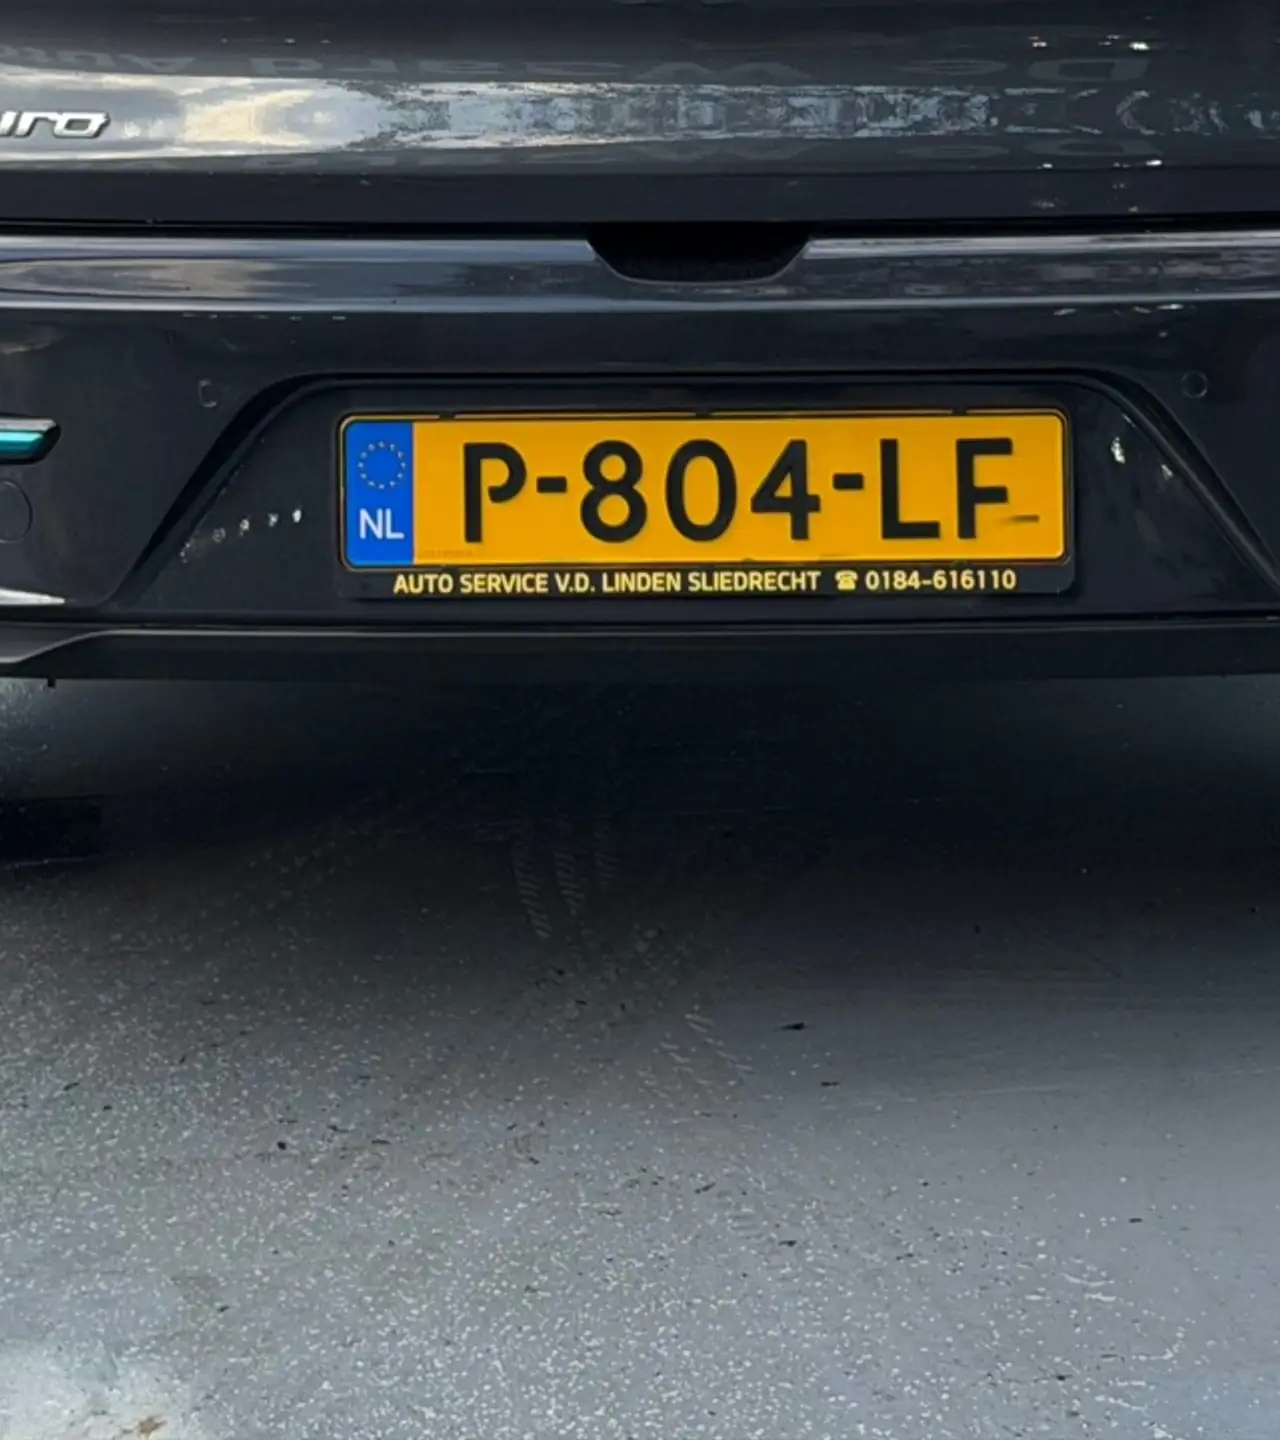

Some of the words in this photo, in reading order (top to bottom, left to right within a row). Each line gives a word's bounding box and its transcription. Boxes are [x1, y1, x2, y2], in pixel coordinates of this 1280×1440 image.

[463, 437, 1014, 544] P-804-LF
[359, 508, 405, 540] NL
[393, 573, 455, 594] AUTO
[459, 572, 549, 594] SERVICE
[553, 572, 596, 593] V.D.
[601, 571, 682, 592] LINDEN
[687, 570, 821, 592] SLIEDRECHT
[865, 569, 1017, 591] 0184-616110
